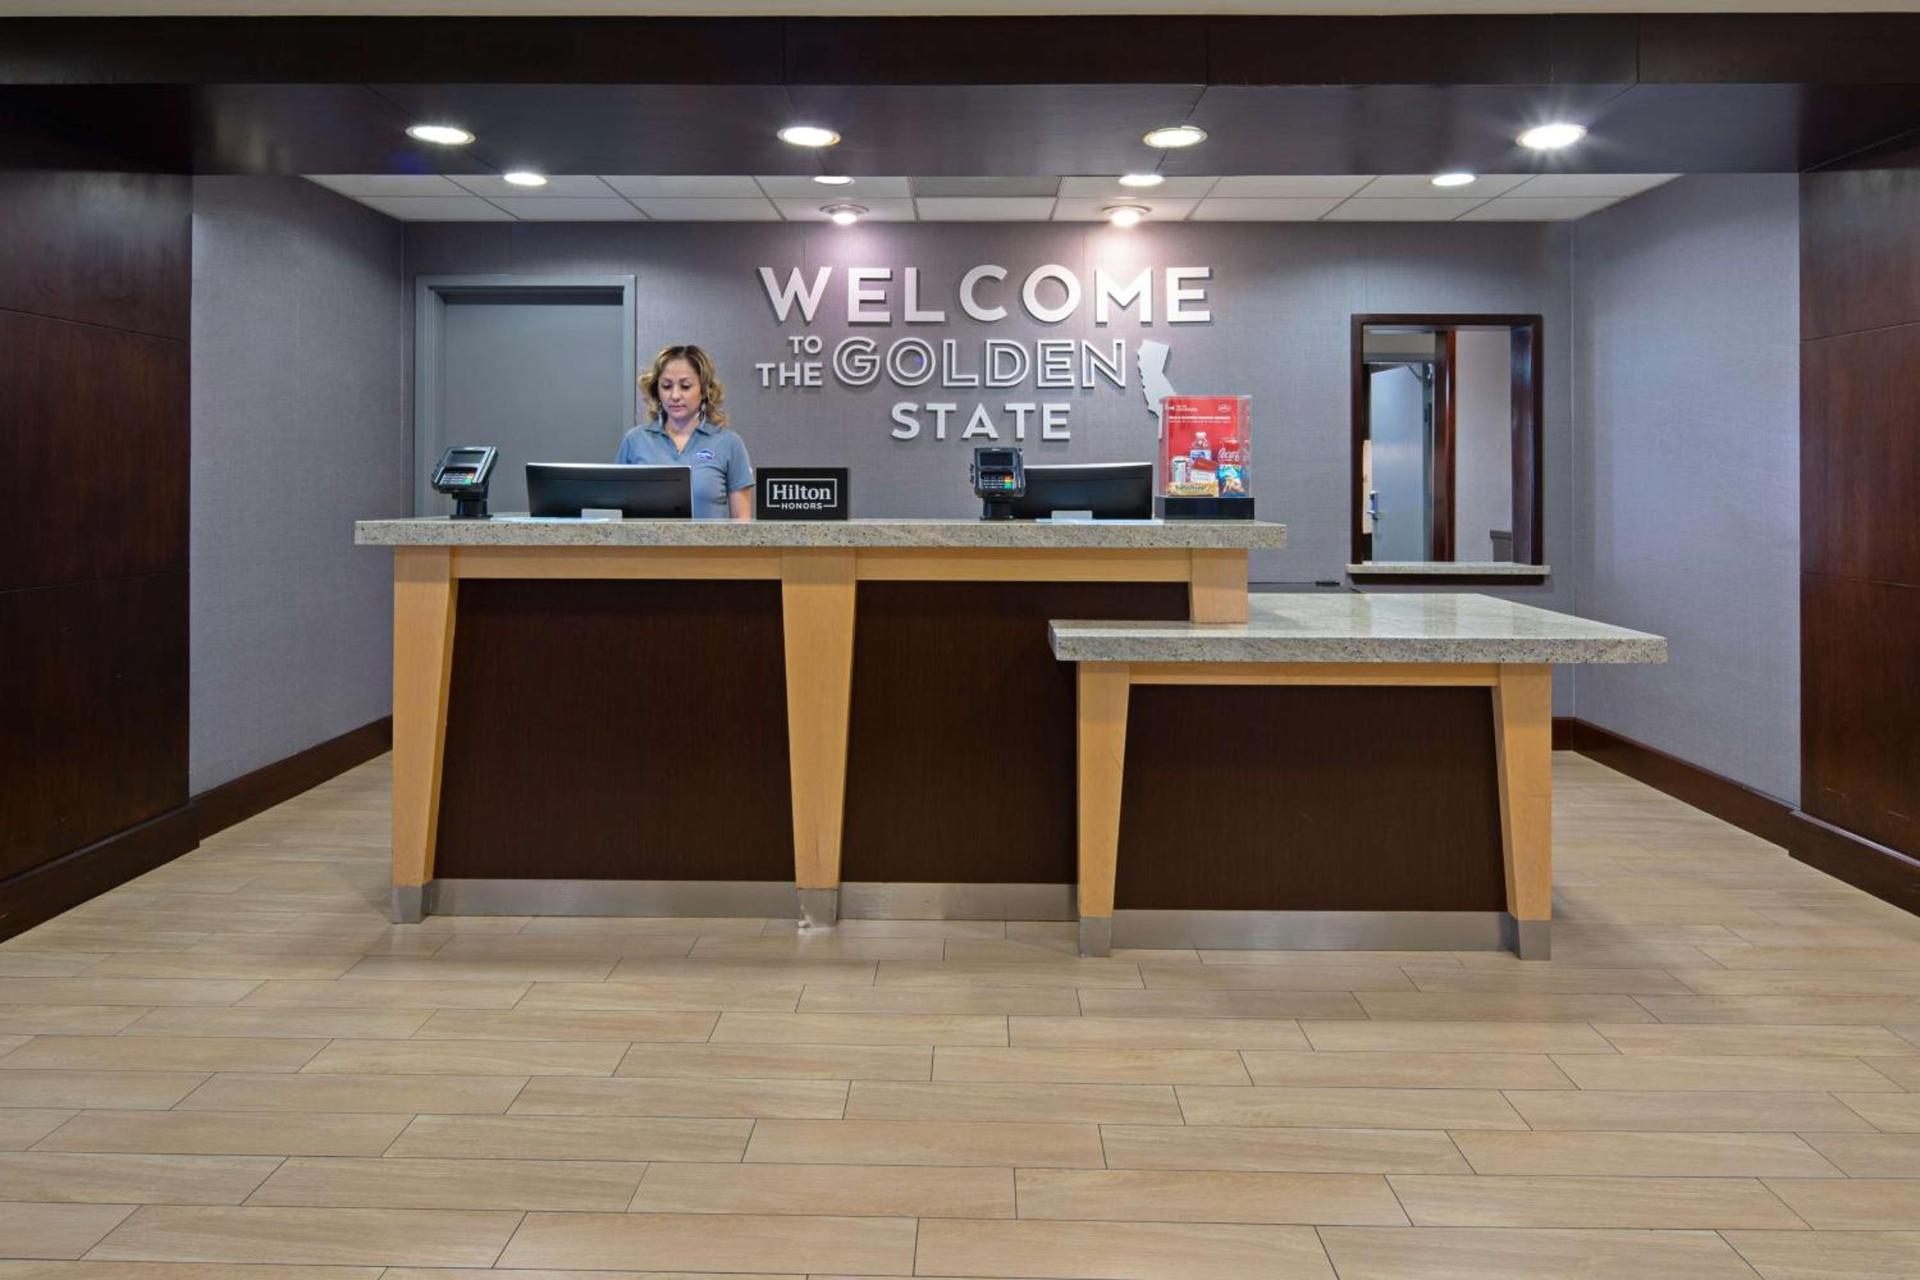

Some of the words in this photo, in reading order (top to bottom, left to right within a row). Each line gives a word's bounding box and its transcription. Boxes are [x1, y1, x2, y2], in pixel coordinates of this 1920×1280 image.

[759, 264, 1211, 323] WELCOME
[788, 335, 823, 355] TO
[756, 362, 823, 387] THE
[833, 336, 1126, 388] GOLDEN
[891, 402, 1071, 440] STATE
[772, 484, 832, 500] Hilton
[781, 502, 823, 510] HONORS
